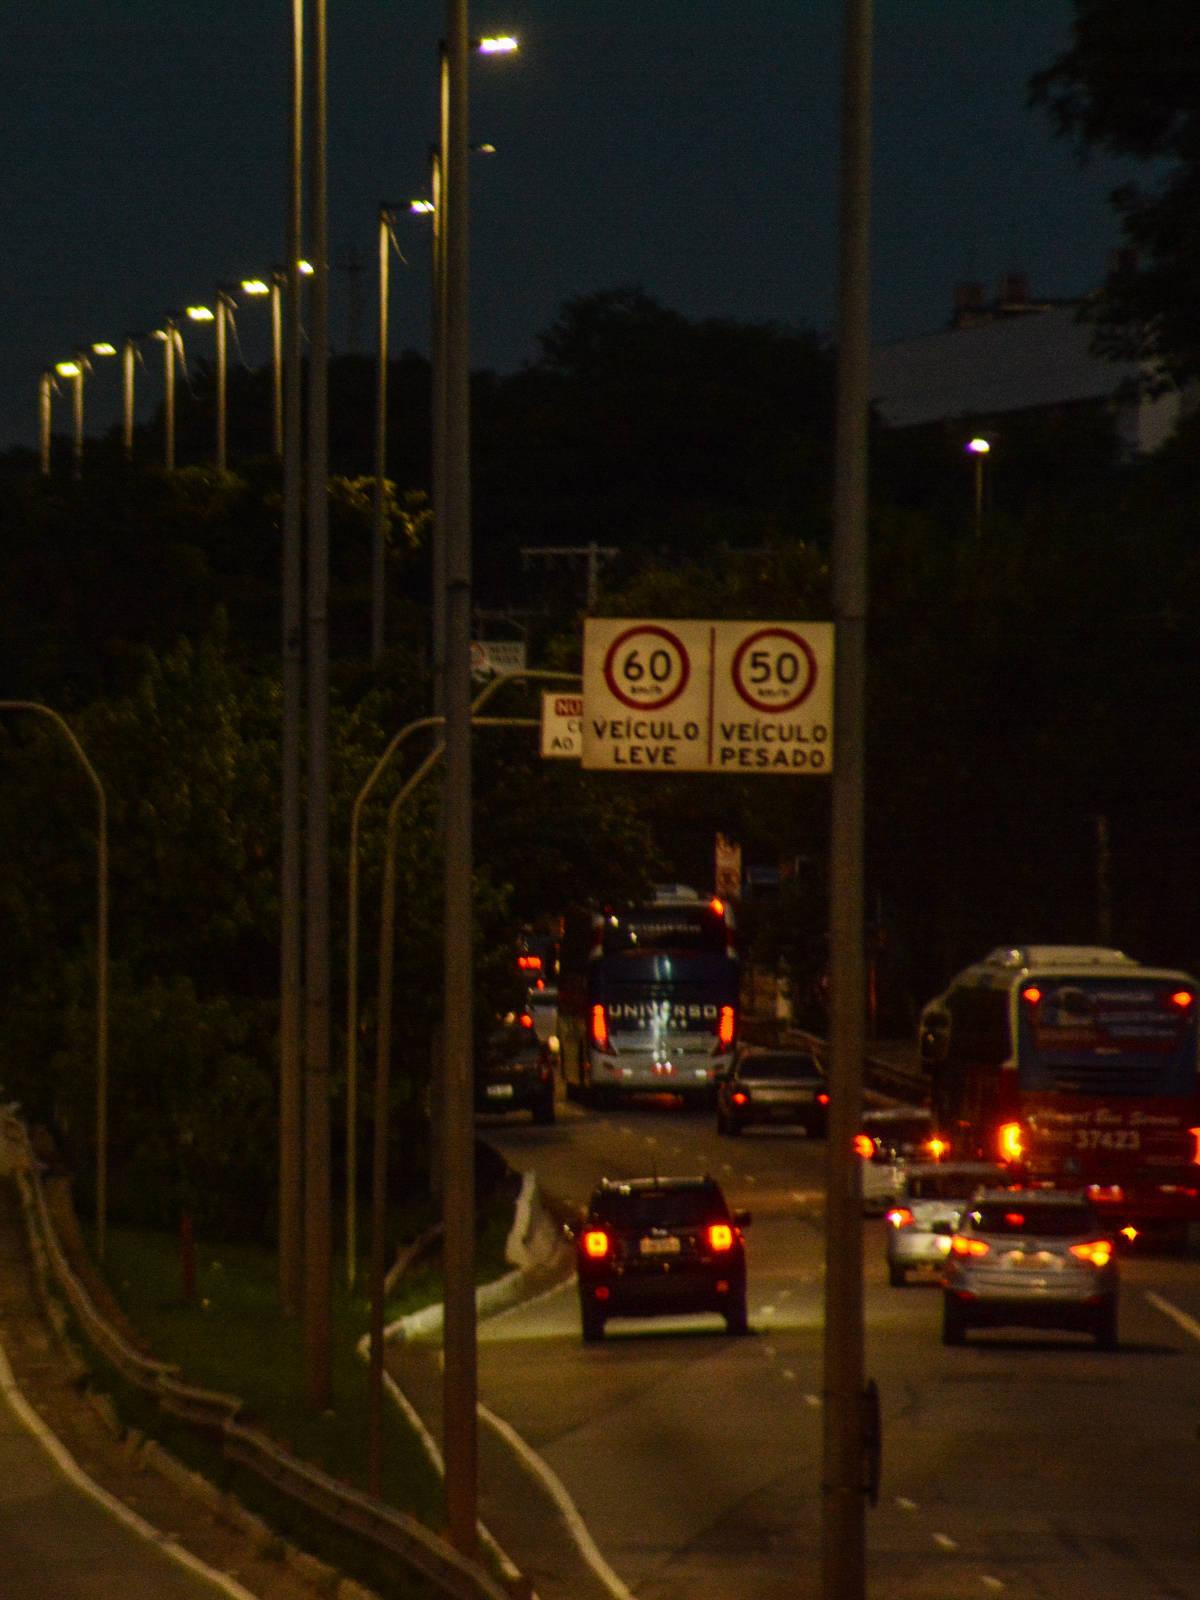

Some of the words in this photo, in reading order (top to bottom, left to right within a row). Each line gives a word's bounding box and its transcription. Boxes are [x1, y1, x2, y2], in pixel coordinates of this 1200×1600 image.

[623, 650, 672, 682] 60
[750, 652, 800, 684] 50
[593, 717, 700, 741] VEÍCULO
[721, 719, 829, 744] VEÍCULO
[552, 736, 575, 750] AO
[614, 746, 677, 766] LEVE
[720, 748, 826, 769] PESADO
[1075, 1129, 1141, 1151] 37423
